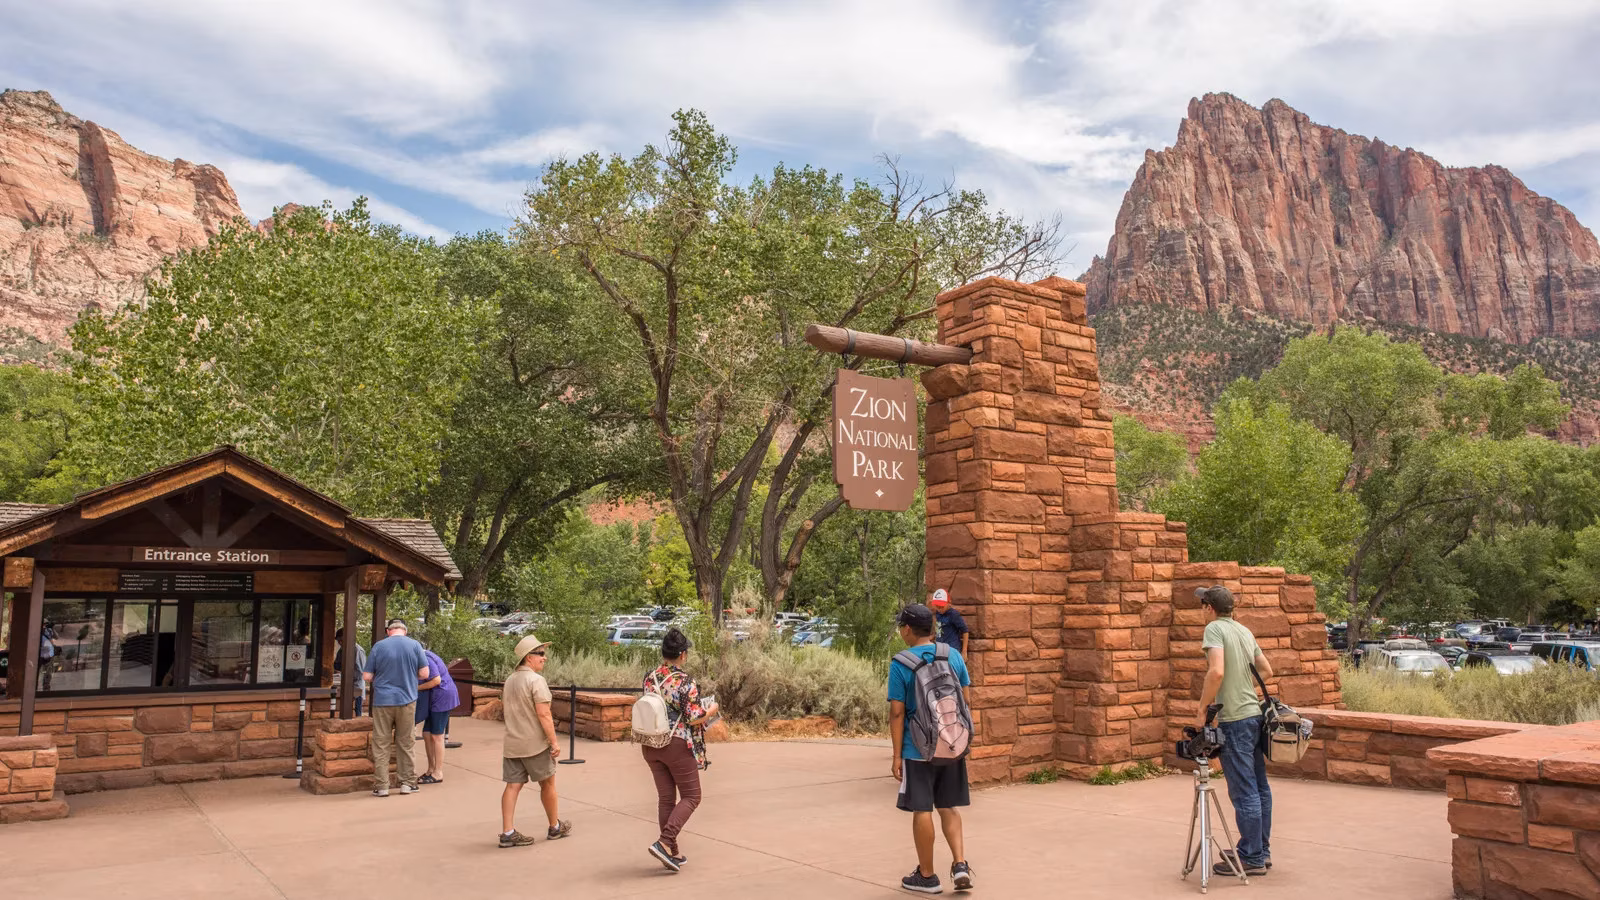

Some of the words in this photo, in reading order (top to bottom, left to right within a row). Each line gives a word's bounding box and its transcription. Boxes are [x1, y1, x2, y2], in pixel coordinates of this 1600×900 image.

[850, 387, 906, 422] ZION
[839, 418, 916, 451] NATIONAL
[853, 451, 904, 481] PARK
[144, 549, 211, 561] Entrance
[217, 550, 269, 562] Station
